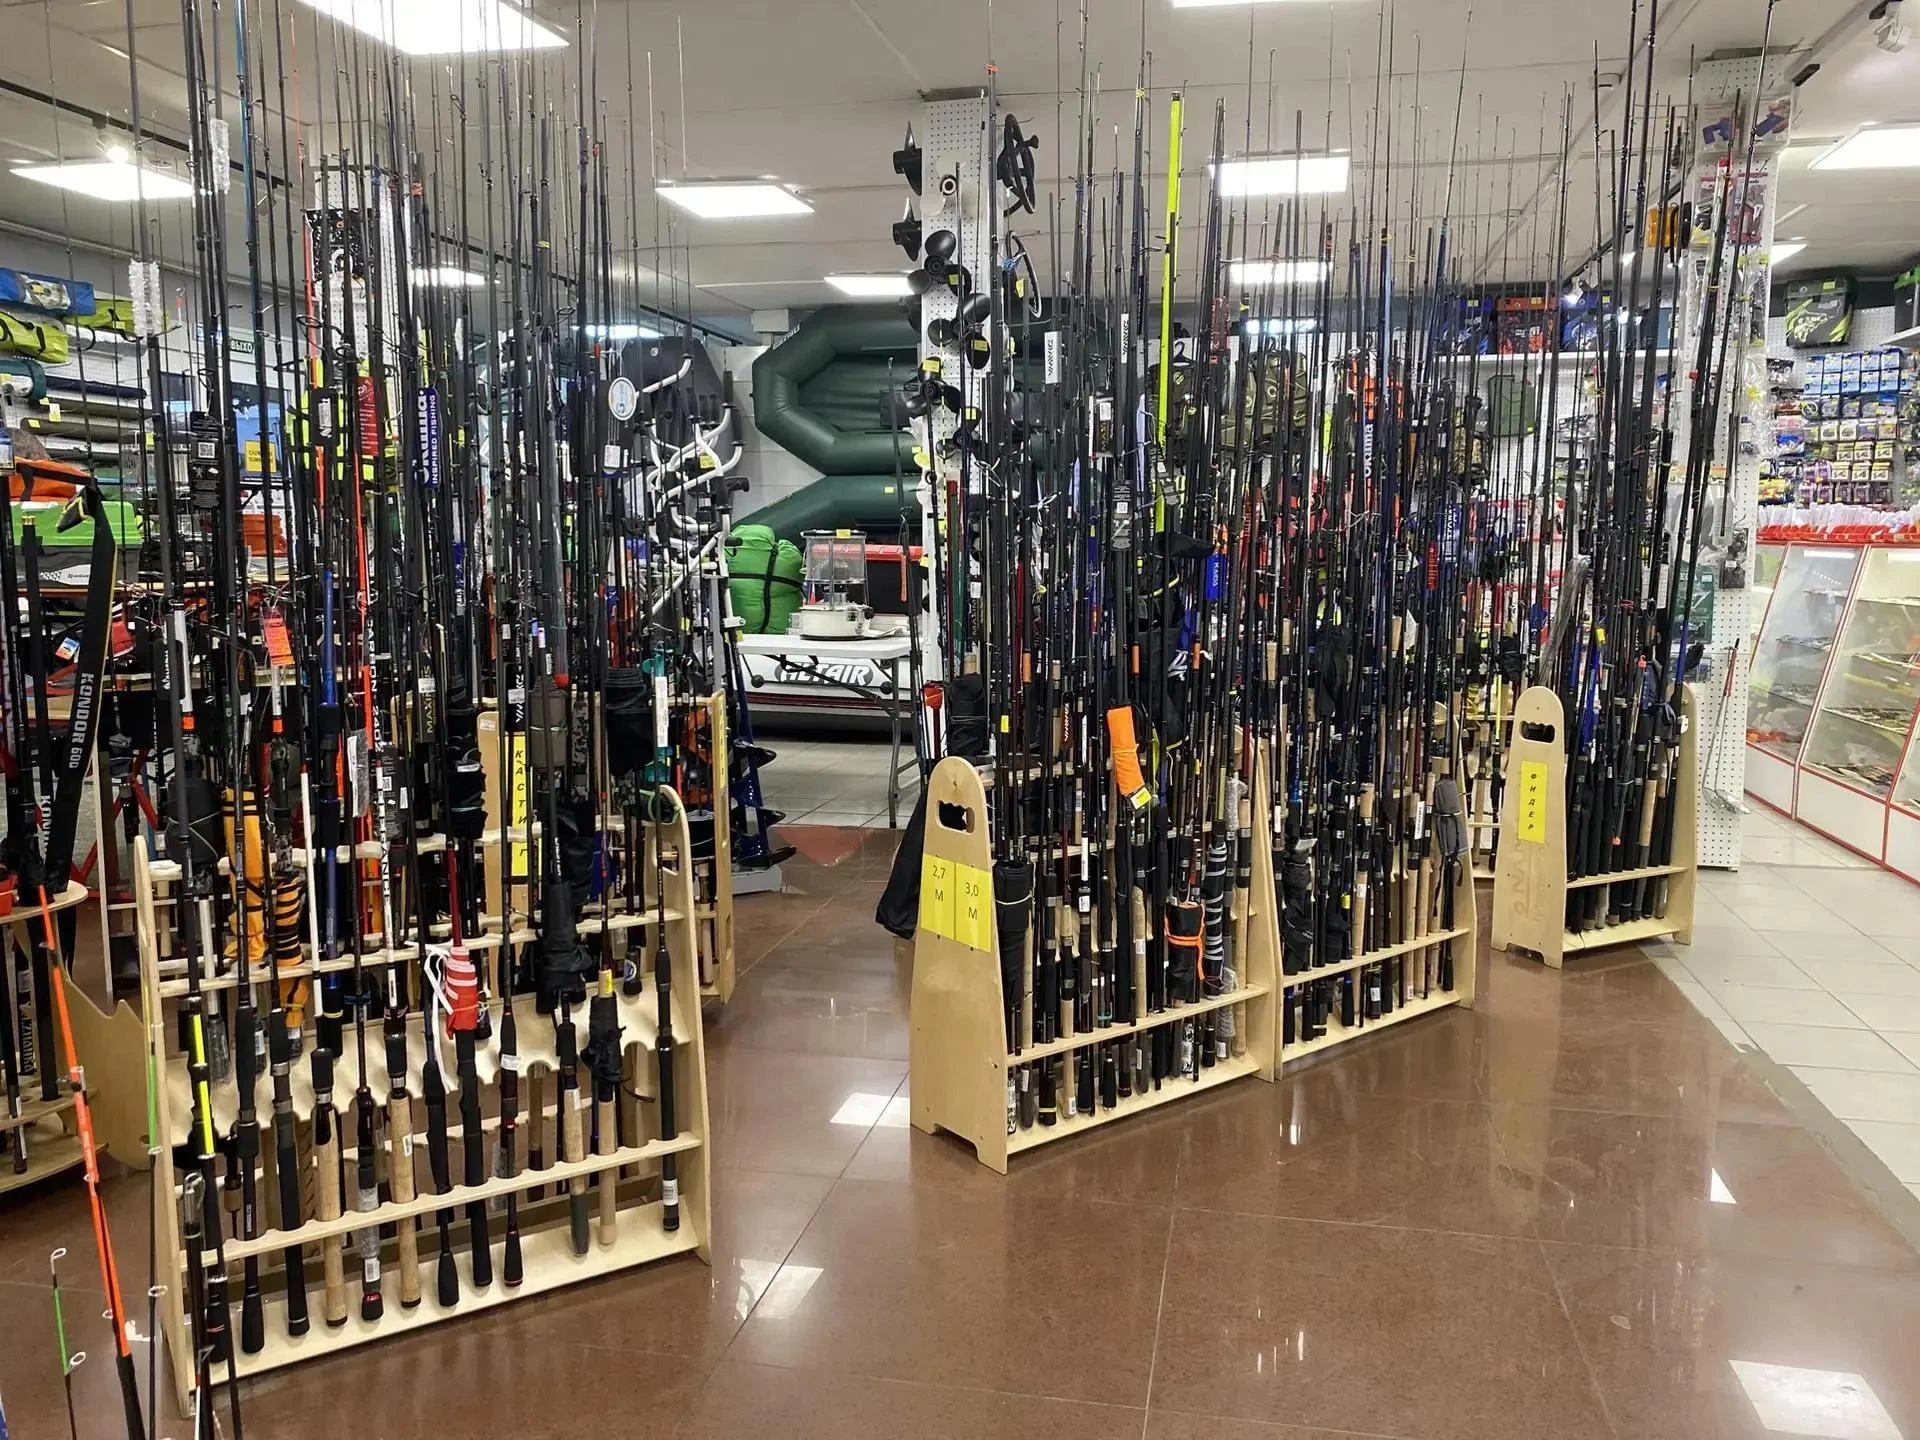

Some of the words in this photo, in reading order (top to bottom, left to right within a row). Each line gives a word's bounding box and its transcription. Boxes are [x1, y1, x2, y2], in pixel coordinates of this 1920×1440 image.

[231, 340, 254, 353] ВЫХО
[428, 395, 437, 434] FISHING
[431, 437, 439, 484] INSPIRED
[72, 672, 94, 743] KONDOR
[424, 665, 433, 733] MAXIMS
[514, 750, 528, 857] КАСТИГ
[1527, 773, 1537, 831] ФИДЕР
[932, 865, 946, 879] 2,7
[964, 882, 979, 897] 3,0
